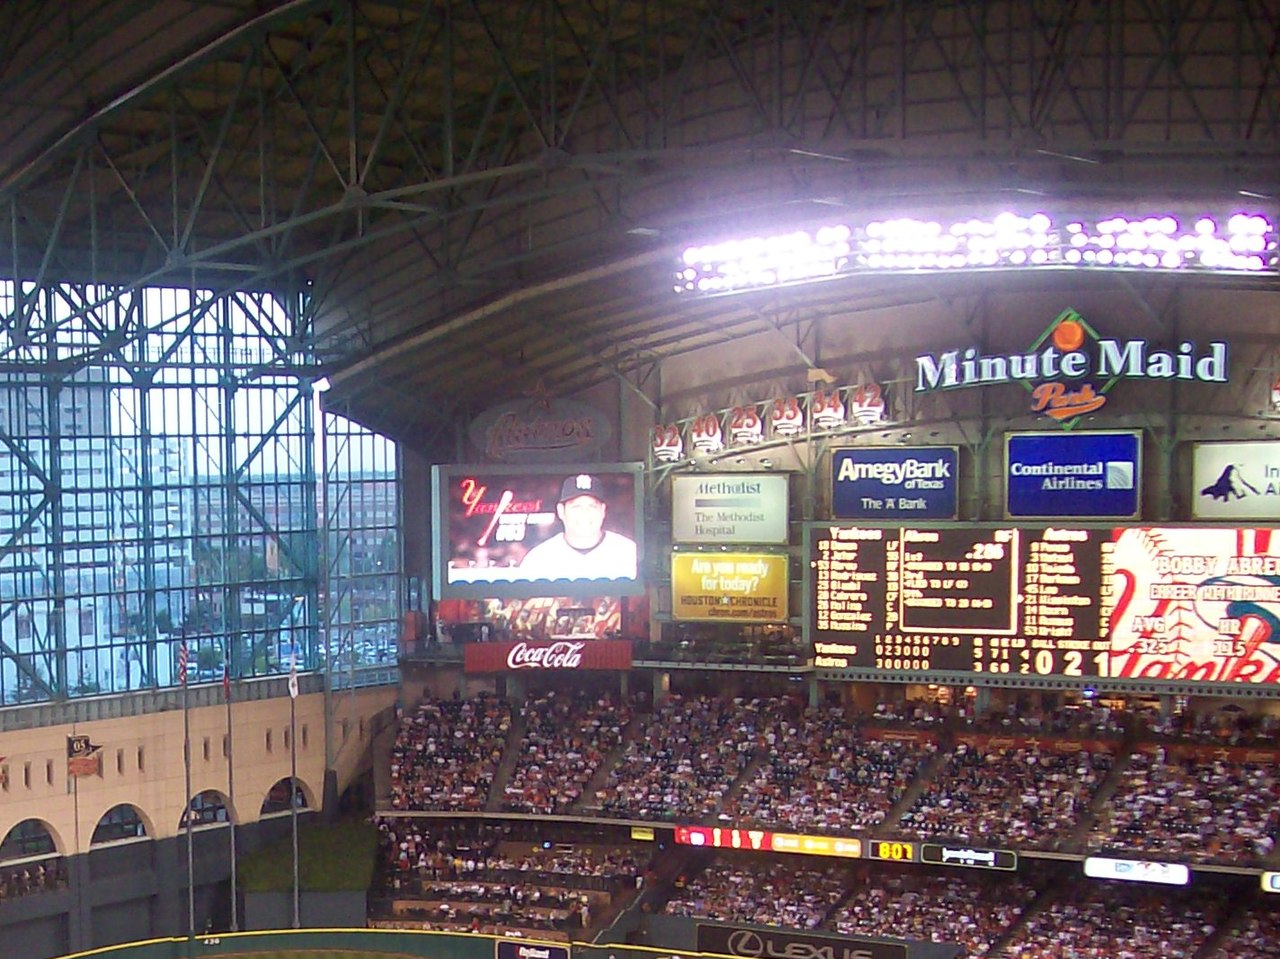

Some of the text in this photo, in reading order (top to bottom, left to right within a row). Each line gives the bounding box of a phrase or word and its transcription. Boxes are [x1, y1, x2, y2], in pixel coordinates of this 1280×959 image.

[915, 338, 1228, 392] Minute Maid
[1031, 382, 1102, 415] Park
[730, 407, 757, 428] 25
[692, 415, 719, 437] 40
[1011, 462, 1103, 476] Continental
[696, 482, 761, 495] Methodist
[917, 480, 944, 489] Texas
[1042, 477, 1103, 490] Airlines
[861, 498, 927, 509] The Bank
[695, 512, 765, 523] The Methodist
[695, 525, 735, 536] Hospital
[691, 558, 769, 578] Are you ready
[1157, 556, 1217, 574] BOBBY
[702, 575, 759, 595] for today?
[681, 595, 777, 607] HOUSTON CHRONICLE
[1132, 616, 1165, 632] AVG
[894, 646, 902, 655] 3
[973, 648, 983, 658] 5
[990, 648, 999, 658] 7
[1002, 649, 1008, 659] 1
[1020, 650, 1030, 660] 4
[973, 662, 983, 672] 3
[990, 662, 999, 672] 6
[1020, 663, 1030, 674] 2
[1035, 650, 1109, 677] 0 2 1
